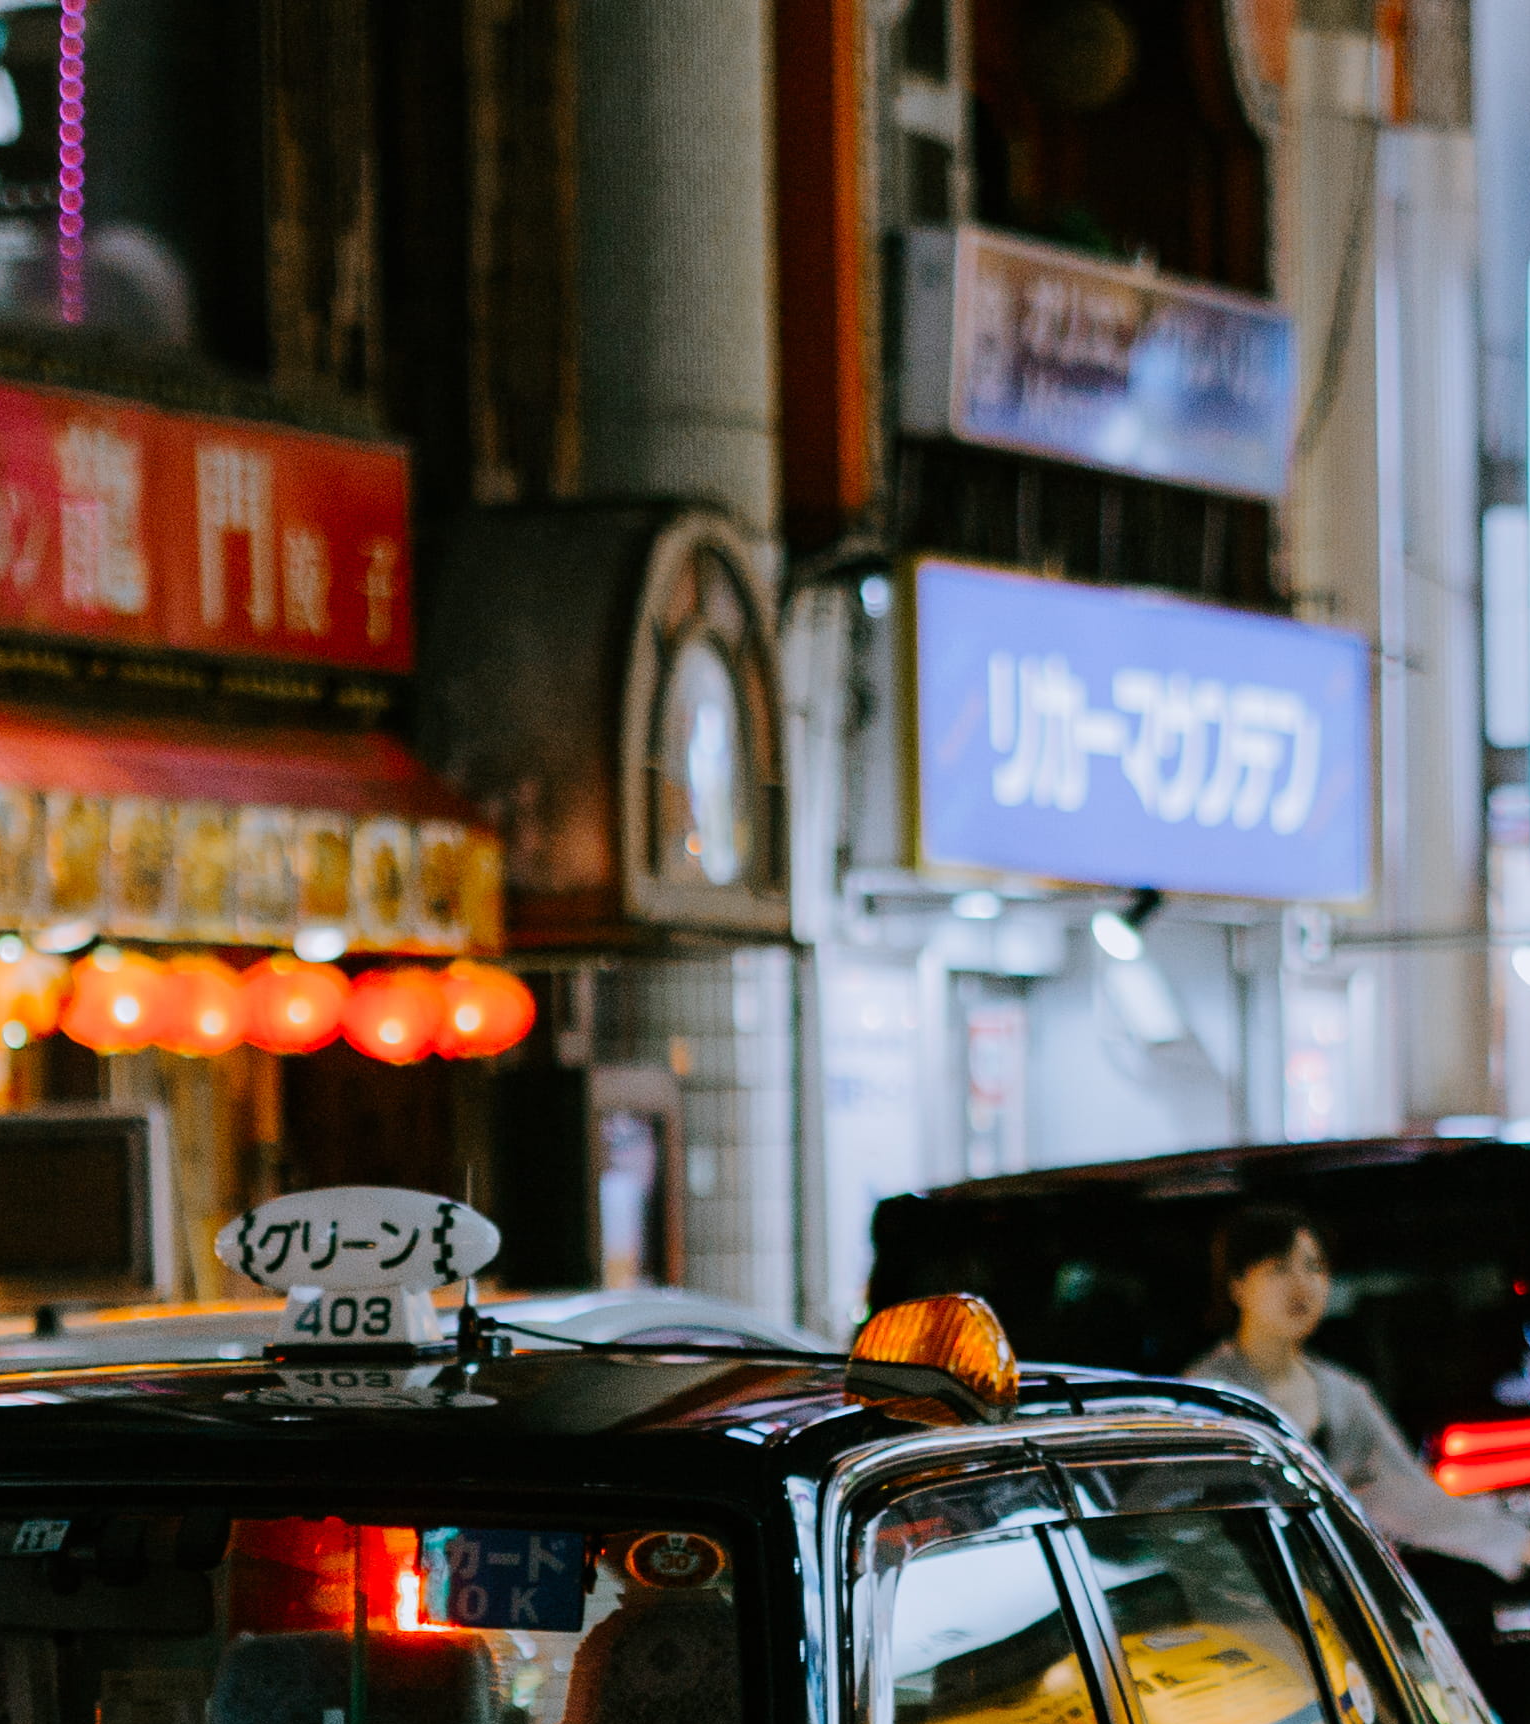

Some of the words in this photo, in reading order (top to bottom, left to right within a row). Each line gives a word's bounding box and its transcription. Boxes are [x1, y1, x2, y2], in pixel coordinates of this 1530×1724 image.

[258, 1220, 420, 1274] グリーン
[294, 1297, 391, 1337] 403
[448, 1533, 567, 1583] カード
